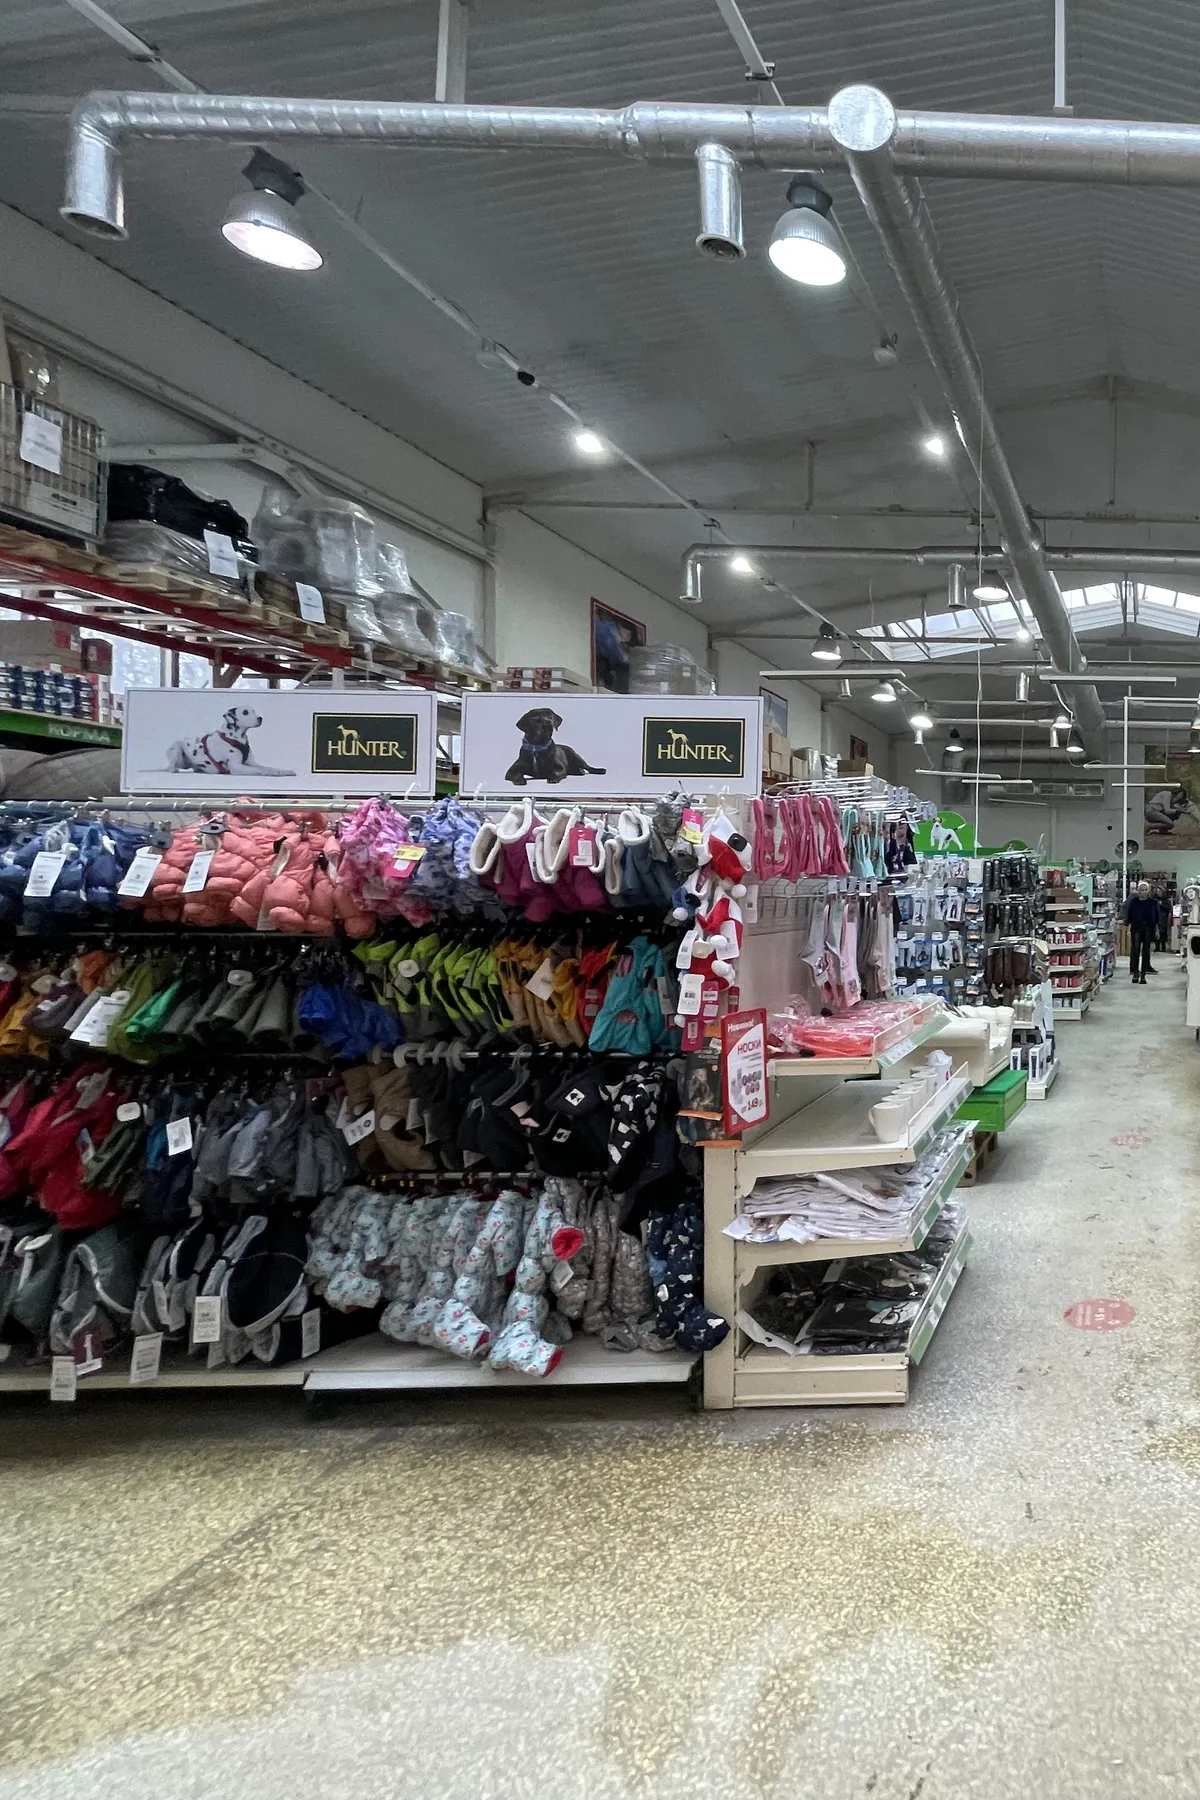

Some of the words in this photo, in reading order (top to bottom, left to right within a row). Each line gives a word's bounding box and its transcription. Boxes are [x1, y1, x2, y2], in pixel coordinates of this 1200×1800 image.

[328, 740, 405, 759] HUNTER
[657, 743, 731, 763] HUNTER
[738, 1039, 761, 1054] НОСКИ
